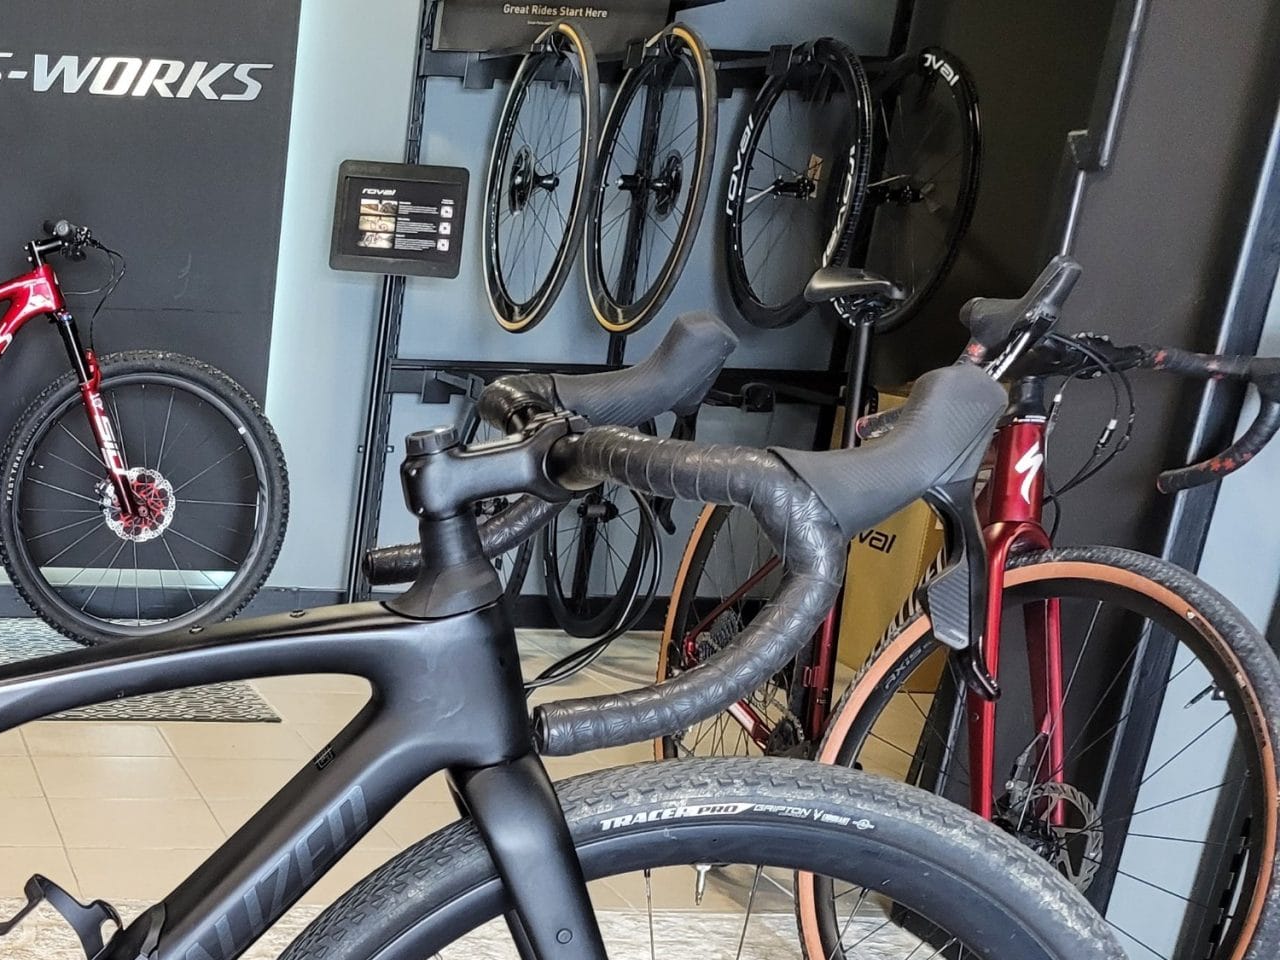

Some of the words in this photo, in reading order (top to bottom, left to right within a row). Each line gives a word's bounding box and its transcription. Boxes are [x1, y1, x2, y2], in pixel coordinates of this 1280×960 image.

[503, 3, 530, 15] Great
[532, 4, 558, 16] Rides
[559, 6, 583, 17] Start
[585, 7, 608, 18] Here
[726, 113, 754, 216] roval
[361, 187, 397, 196] roval
[11, 449, 25, 474] TRAK
[6, 476, 16, 501] FAST
[599, 806, 697, 831] TRACER
[697, 804, 738, 815] PRO
[753, 803, 812, 817] GRIPTON
